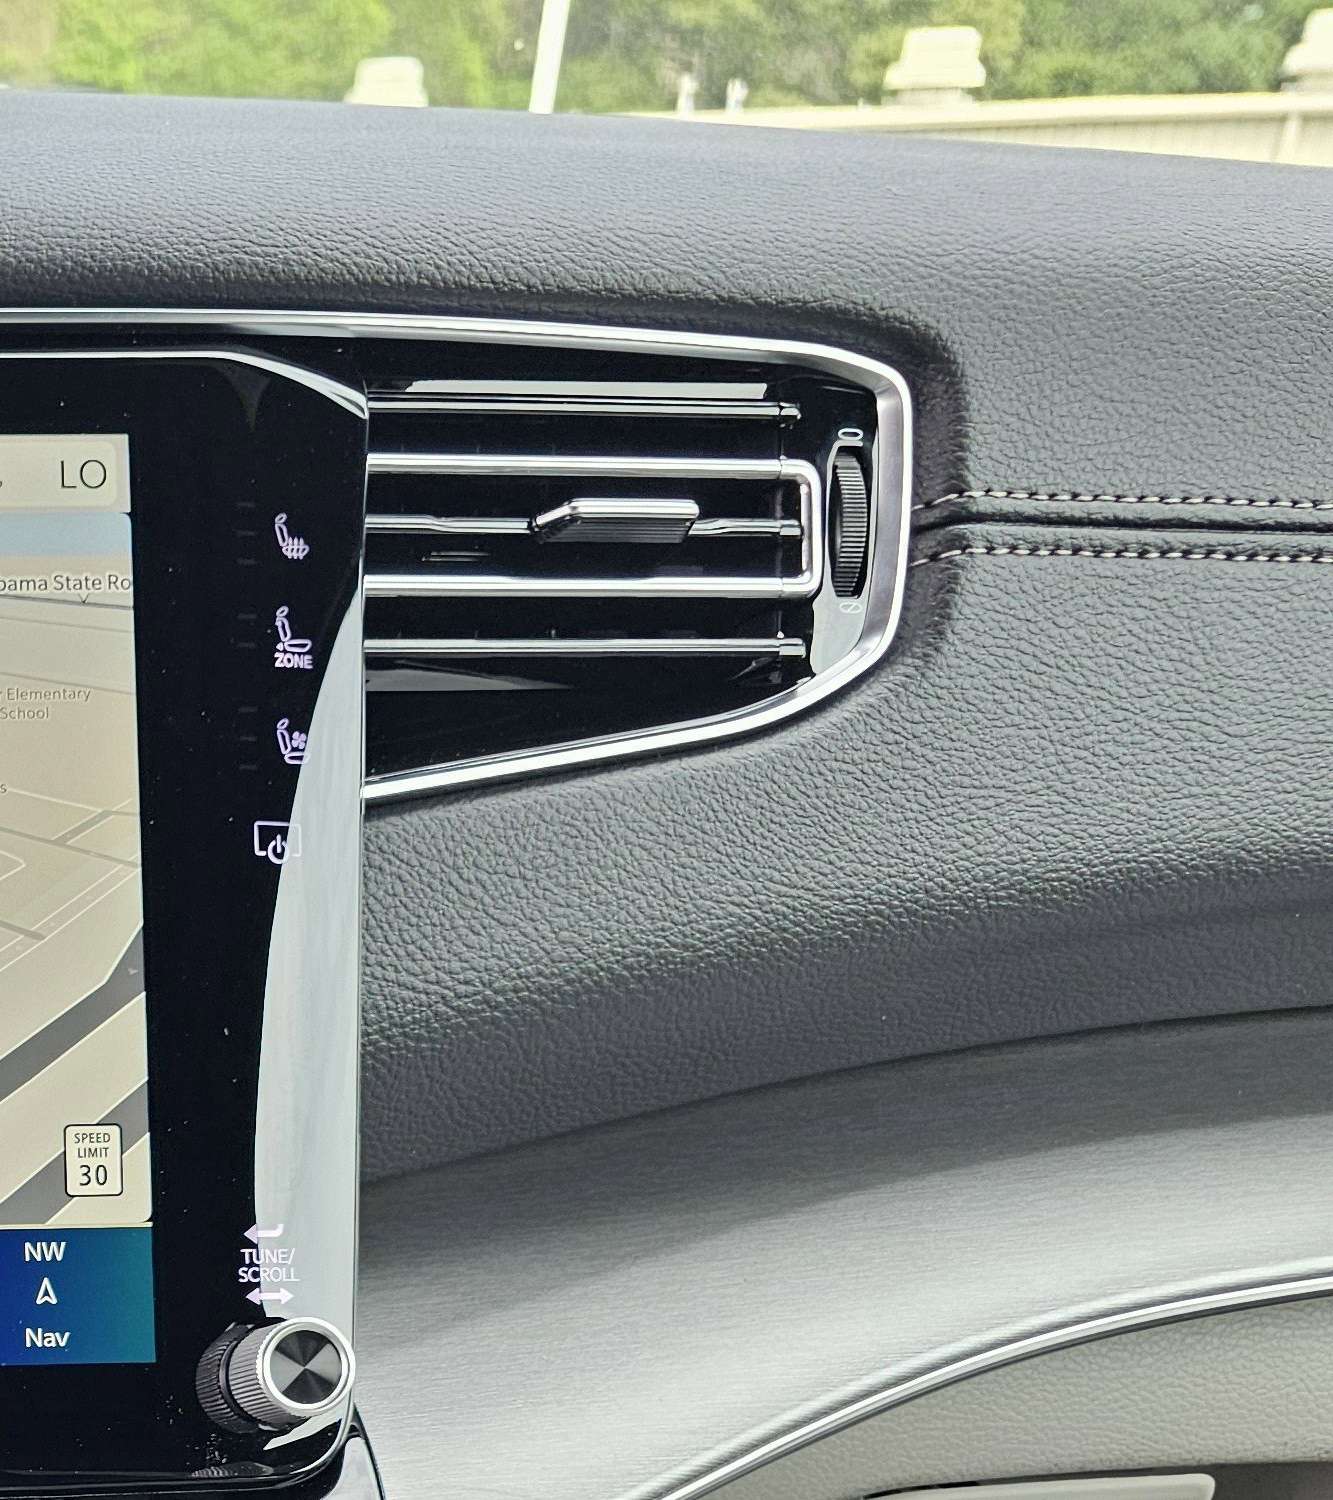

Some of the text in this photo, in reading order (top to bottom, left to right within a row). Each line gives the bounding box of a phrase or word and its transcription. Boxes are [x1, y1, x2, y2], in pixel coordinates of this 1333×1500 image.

[60, 459, 108, 489] LO
[53, 574, 102, 592] State
[275, 653, 313, 669] ZONE
[7, 687, 91, 702] Elementary
[0, 707, 49, 720] School
[74, 1132, 111, 1144] SPEED
[77, 1147, 110, 1158] LIMIT
[79, 1164, 109, 1187] 30
[24, 1241, 65, 1262] NW
[240, 1248, 295, 1265] TUNE/
[238, 1267, 299, 1283] SCROLL
[25, 1328, 70, 1349] Nav
